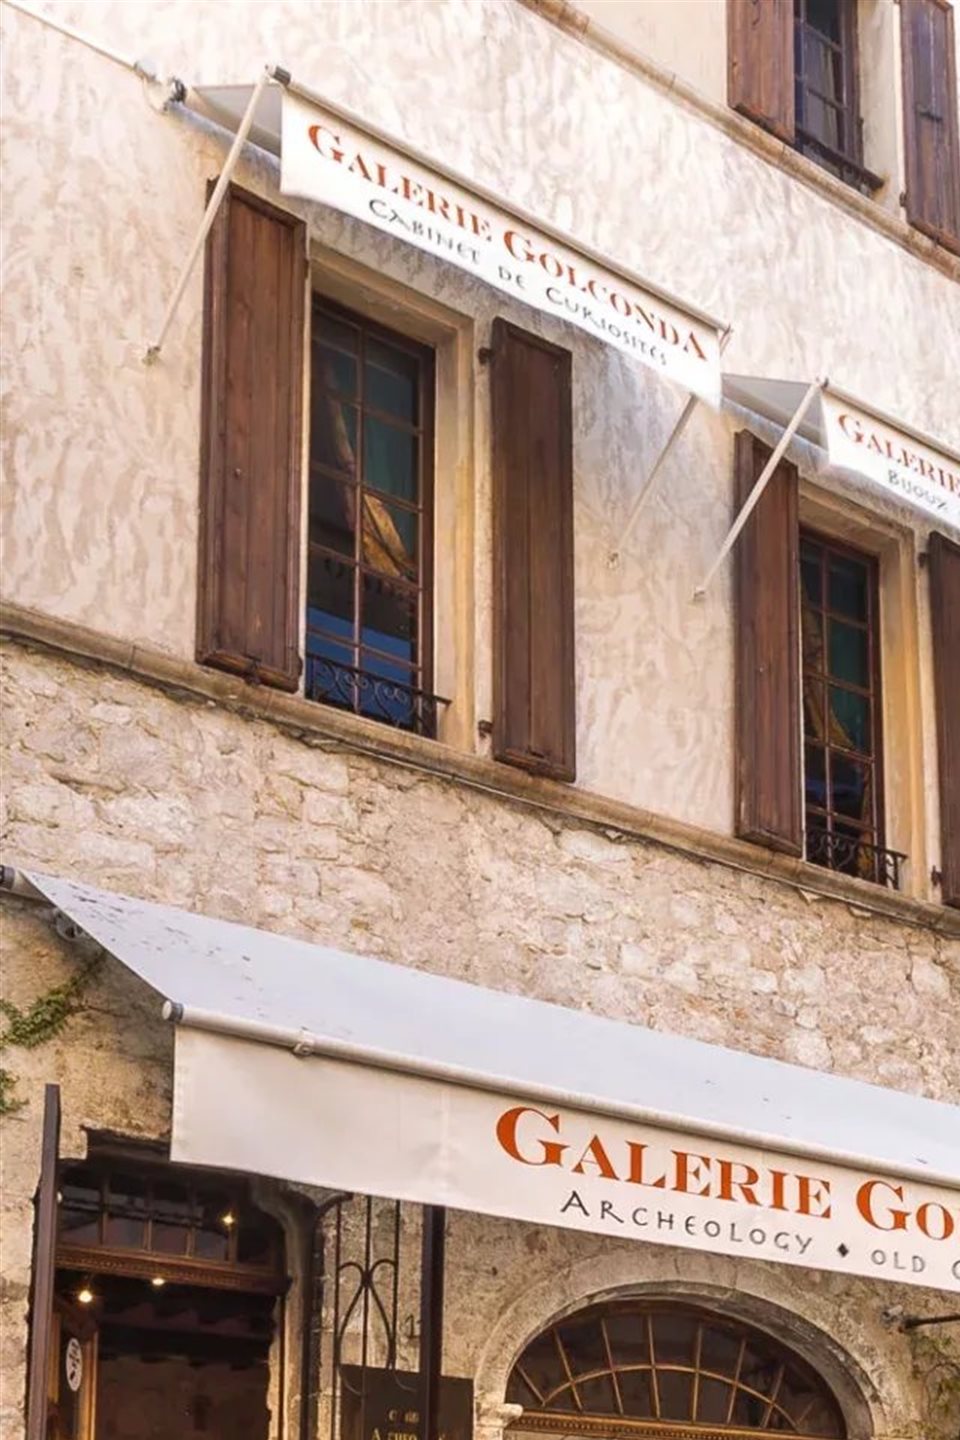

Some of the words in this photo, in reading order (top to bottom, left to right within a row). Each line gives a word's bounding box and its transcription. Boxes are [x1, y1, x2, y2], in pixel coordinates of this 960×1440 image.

[308, 124, 493, 242] GALERIE
[503, 230, 707, 361] GOLCONDA
[368, 198, 481, 264] CABINET
[498, 265, 527, 289] DE
[496, 1106, 832, 1219] GALERIE
[560, 1189, 813, 1255] ARCHEOLOGY
[871, 1249, 926, 1274] OLD
